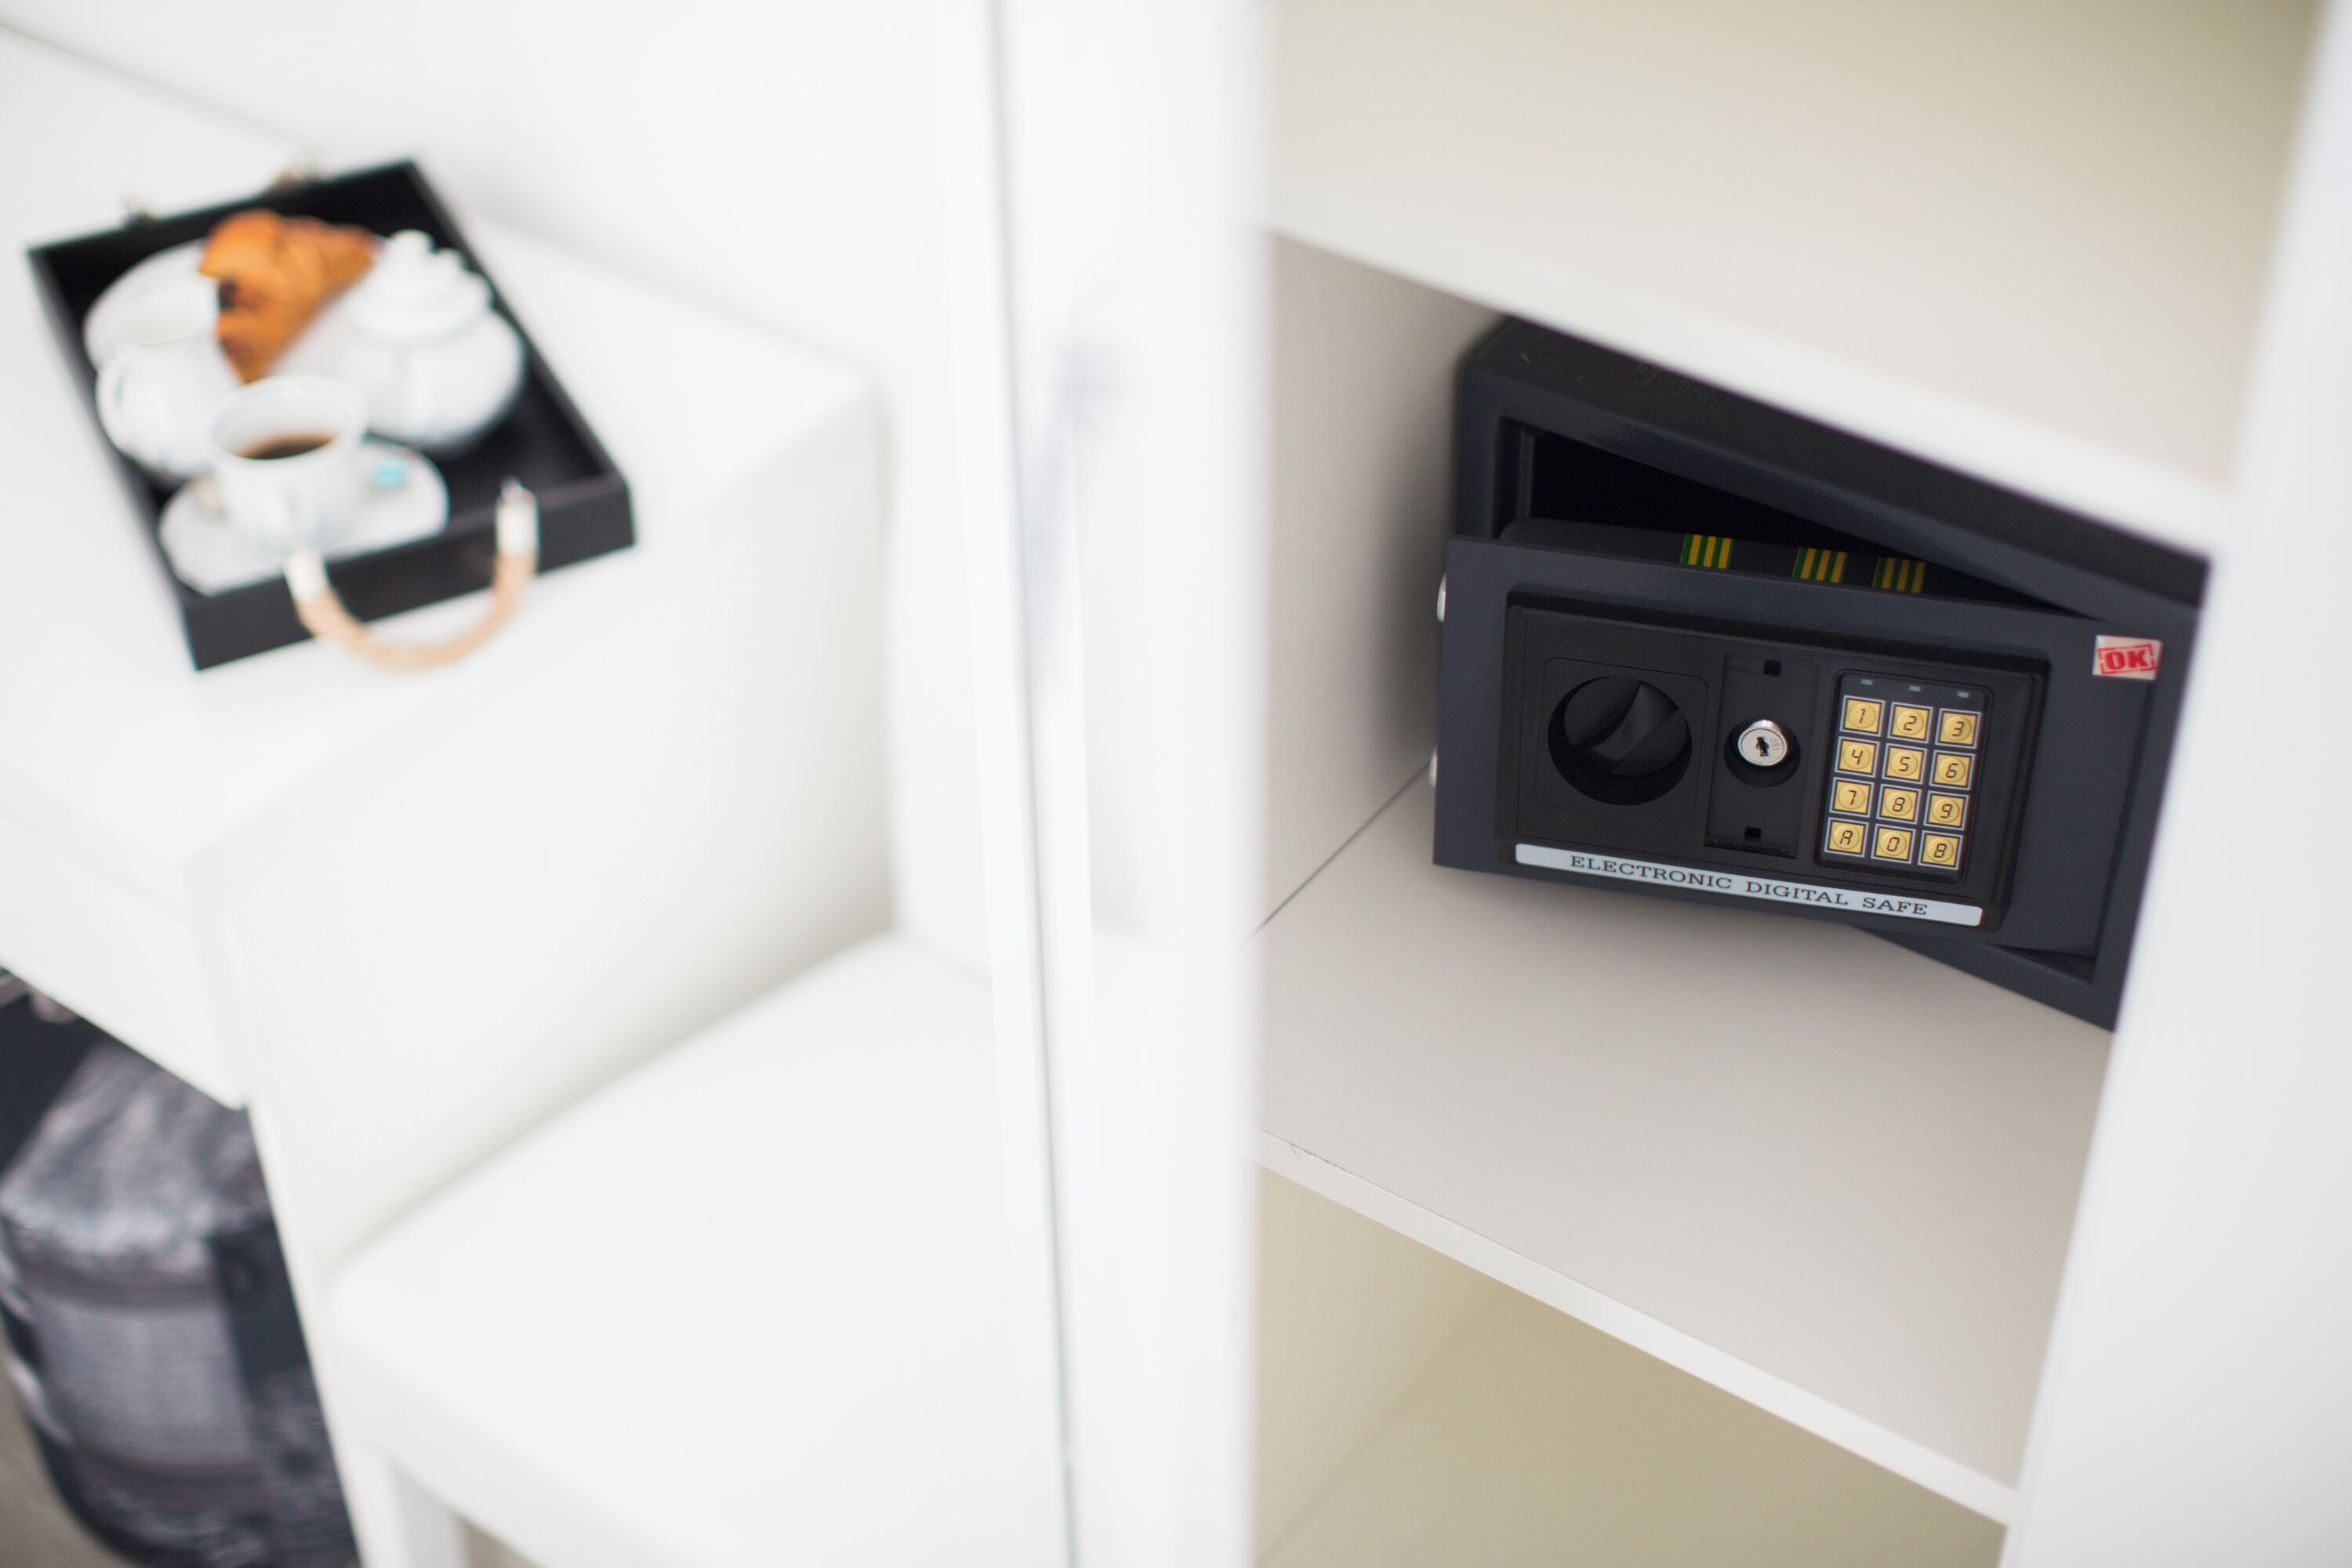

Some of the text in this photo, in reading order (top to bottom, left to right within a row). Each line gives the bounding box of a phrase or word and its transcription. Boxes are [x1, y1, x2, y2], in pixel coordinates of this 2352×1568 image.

[2104, 649, 2148, 670] OK
[1859, 708, 1965, 737] 1 2 3
[1851, 749, 1959, 779] 4 5 6
[1848, 789, 1953, 818] 7 8 9
[1839, 829, 1853, 845] A
[1570, 855, 1928, 916] ELECTRONIC DIGITAL SAFE
